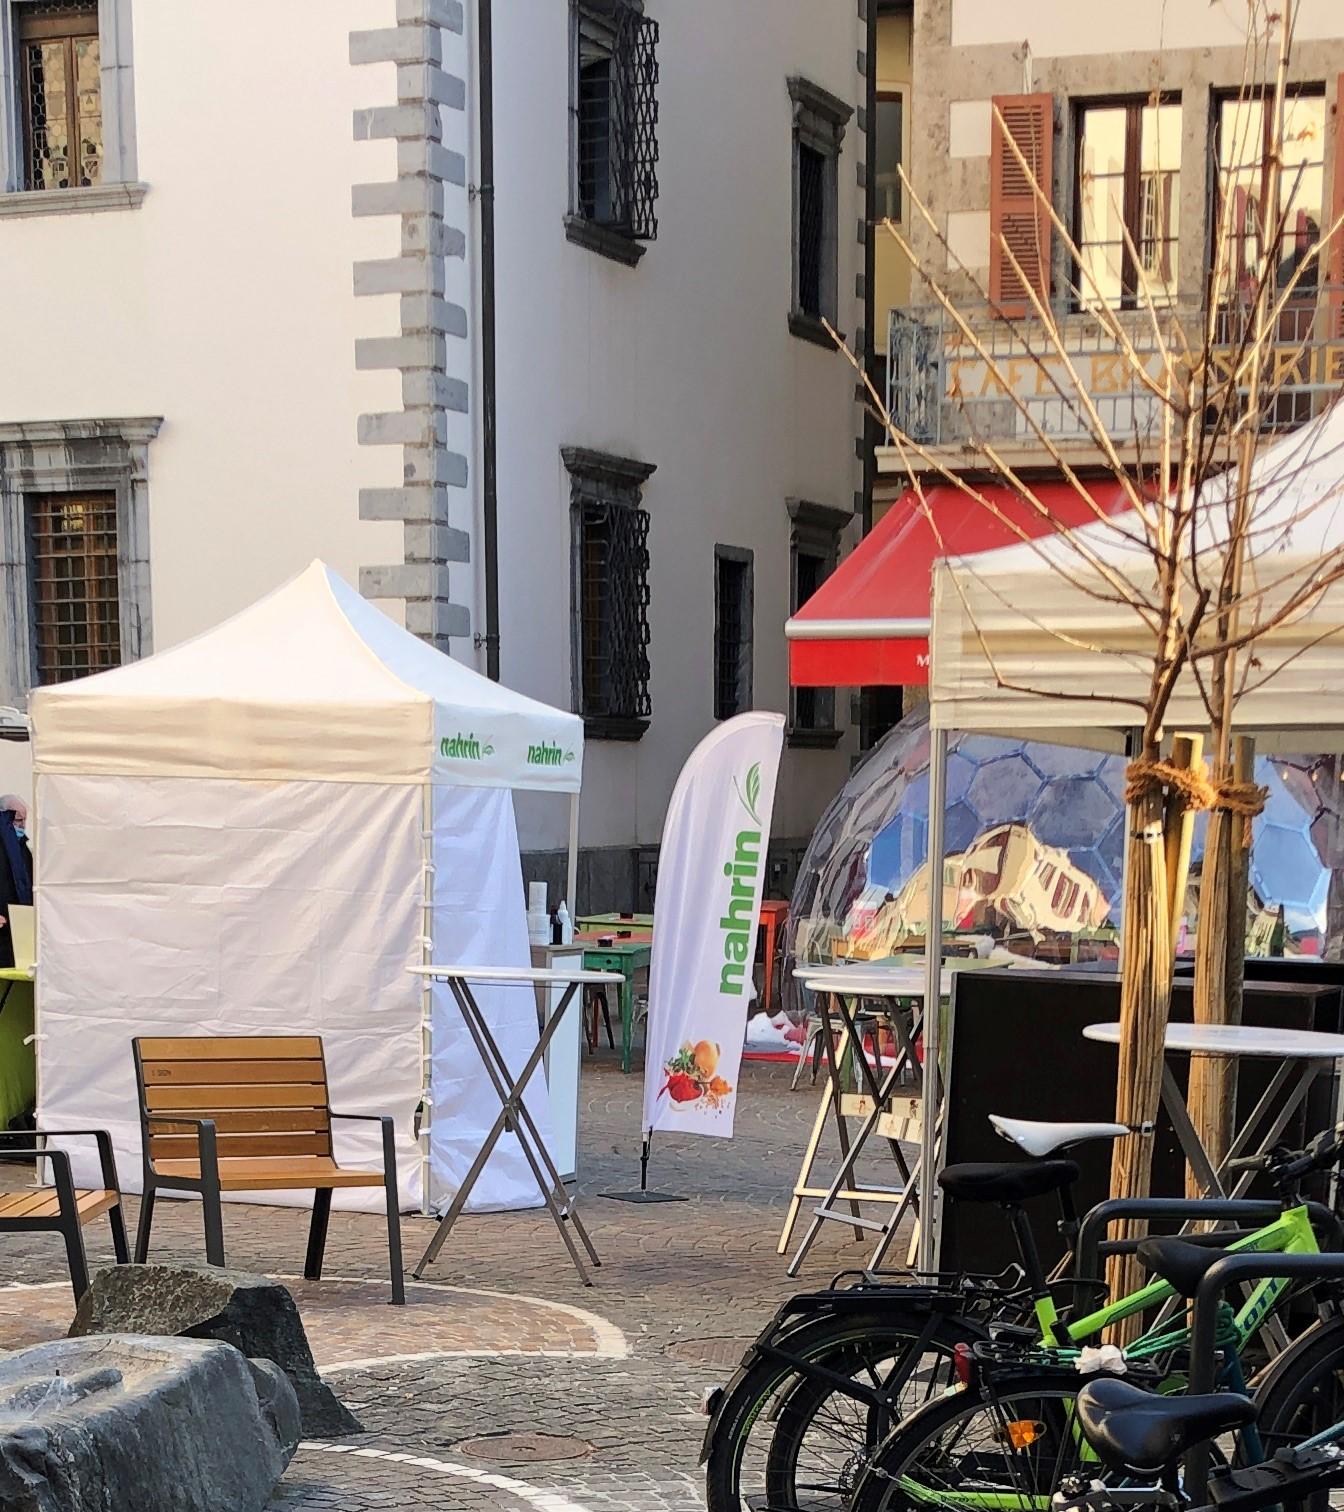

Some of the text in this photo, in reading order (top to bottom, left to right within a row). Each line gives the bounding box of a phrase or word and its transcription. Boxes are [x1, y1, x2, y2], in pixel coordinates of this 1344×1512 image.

[440, 732, 481, 760] nahrin
[527, 740, 563, 766] nahrin
[720, 831, 762, 996] nahrin
[1243, 1277, 1278, 1331] OTT
